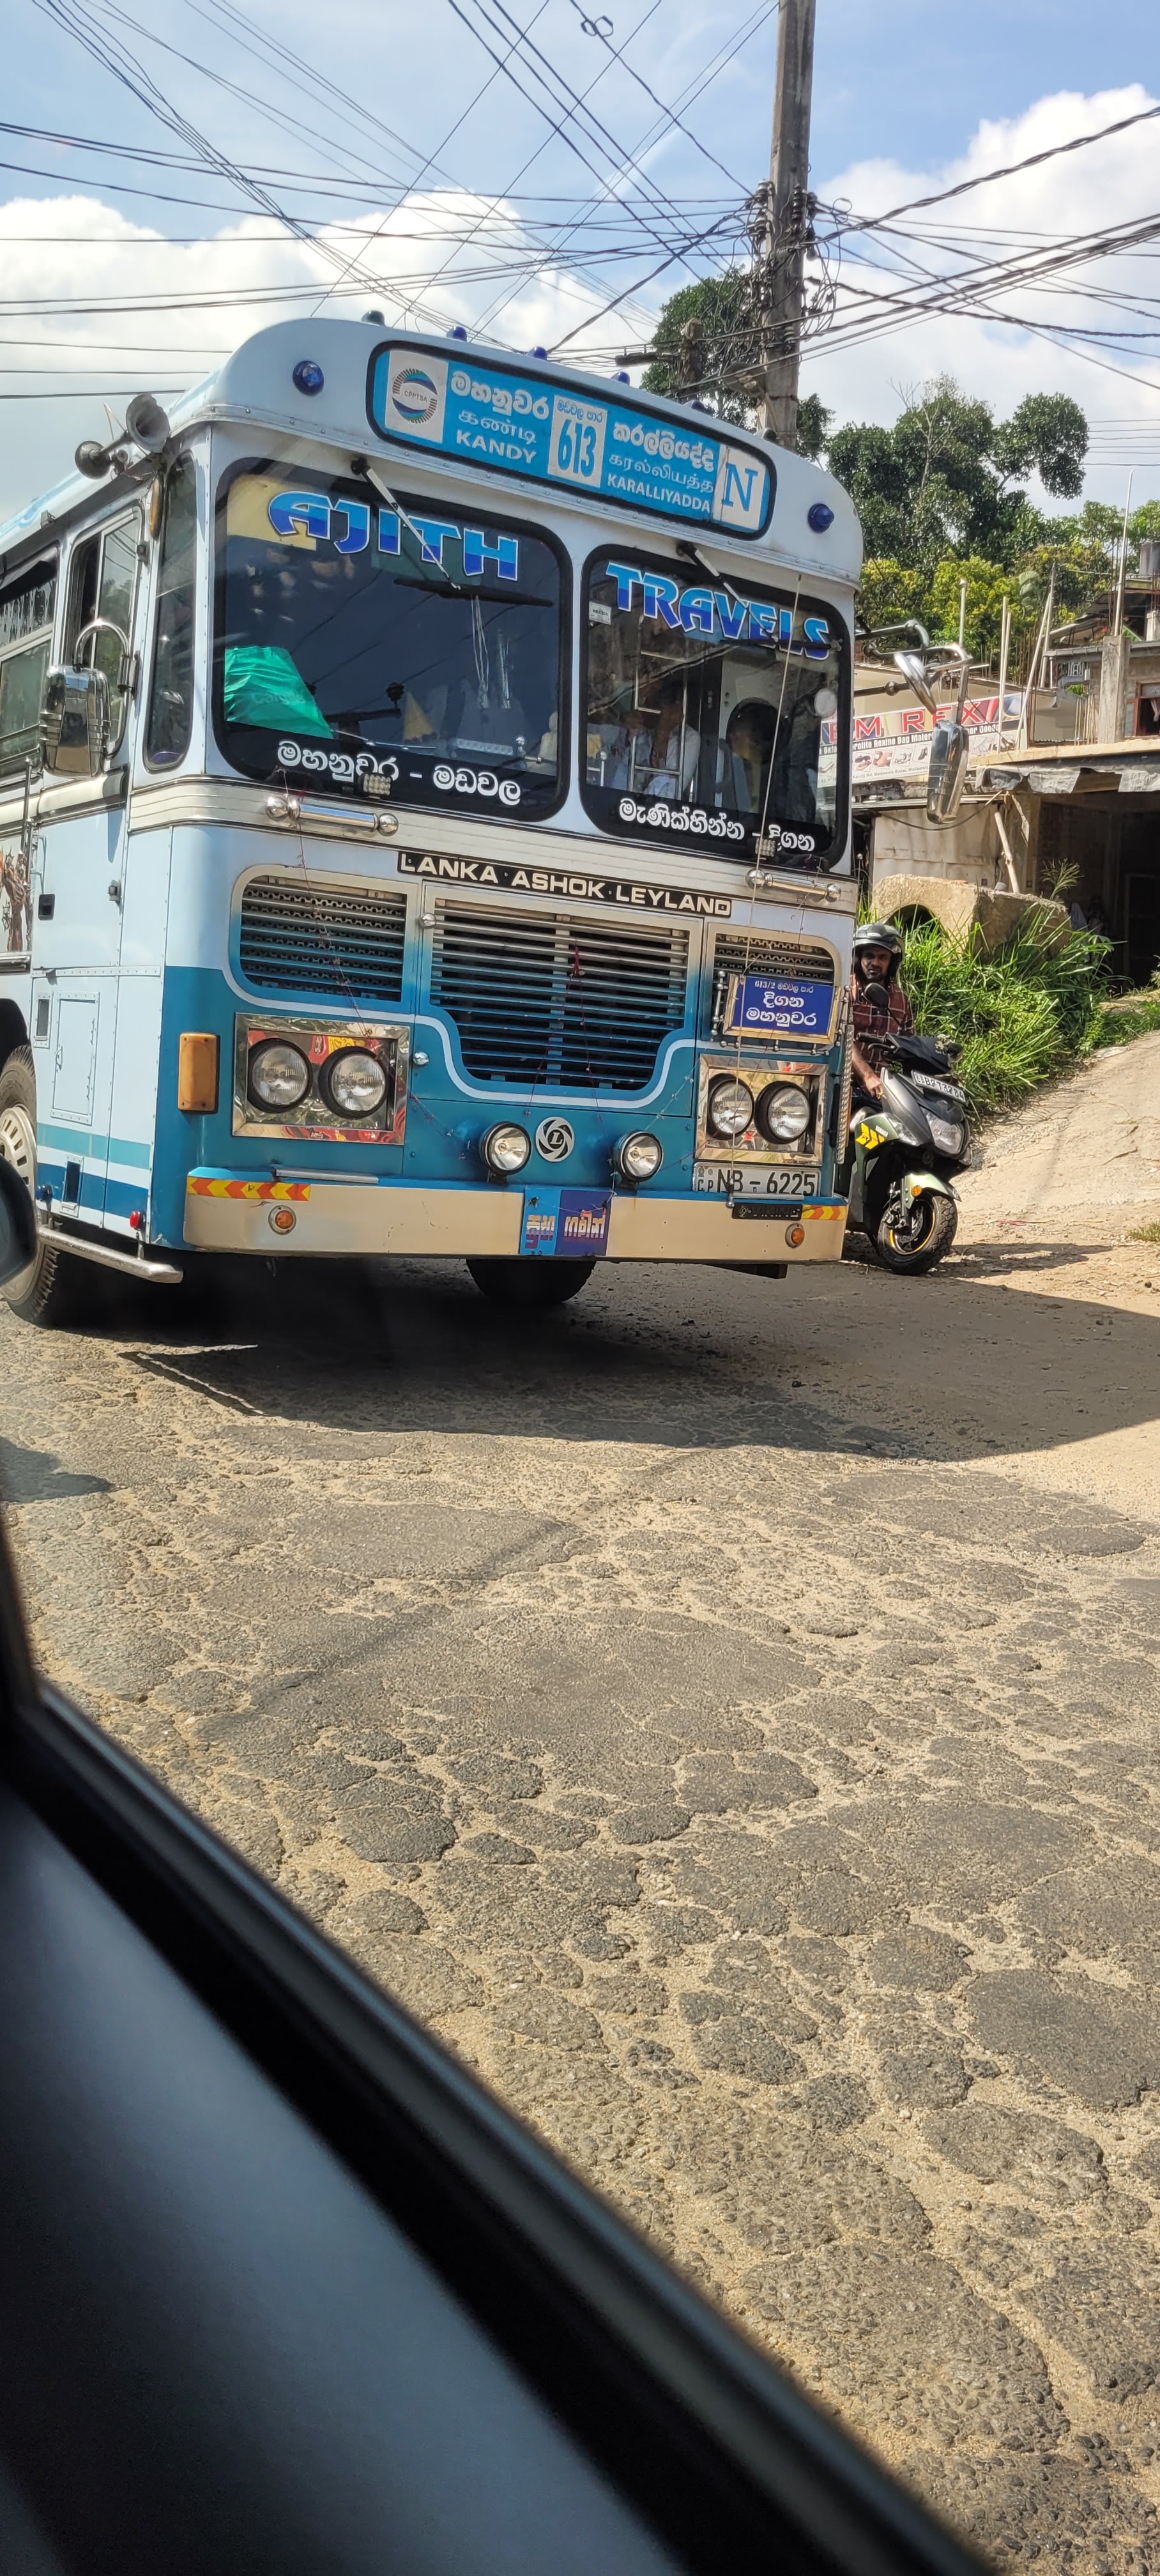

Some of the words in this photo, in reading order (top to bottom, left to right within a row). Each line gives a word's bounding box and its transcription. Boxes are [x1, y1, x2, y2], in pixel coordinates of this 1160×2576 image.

[451, 371, 549, 420] මහනුවර
[458, 410, 537, 445] கண்டி
[586, 410, 603, 423] පාර
[456, 429, 537, 463] KANDY
[557, 418, 597, 478] 613
[607, 473, 711, 512] KARALLIYADDA
[608, 454, 714, 493] கரல்லியத்த
[721, 463, 758, 512] N
[268, 491, 518, 581] AJITH
[606, 562, 830, 661] TRAVELS
[897, 735, 910, 744] Bag
[277, 740, 399, 783] මහනුවර
[433, 765, 521, 806] මඩවල
[619, 798, 745, 840] මැණික්හින්න
[401, 853, 498, 884] LANKA
[511, 870, 606, 899] ASHOK
[616, 885, 731, 916] LEYLAND
[754, 980, 775, 989] 613/2
[763, 992, 805, 1008] දිගන
[746, 1007, 817, 1027] මහනුවර
[767, 1172, 816, 1197] 6225
